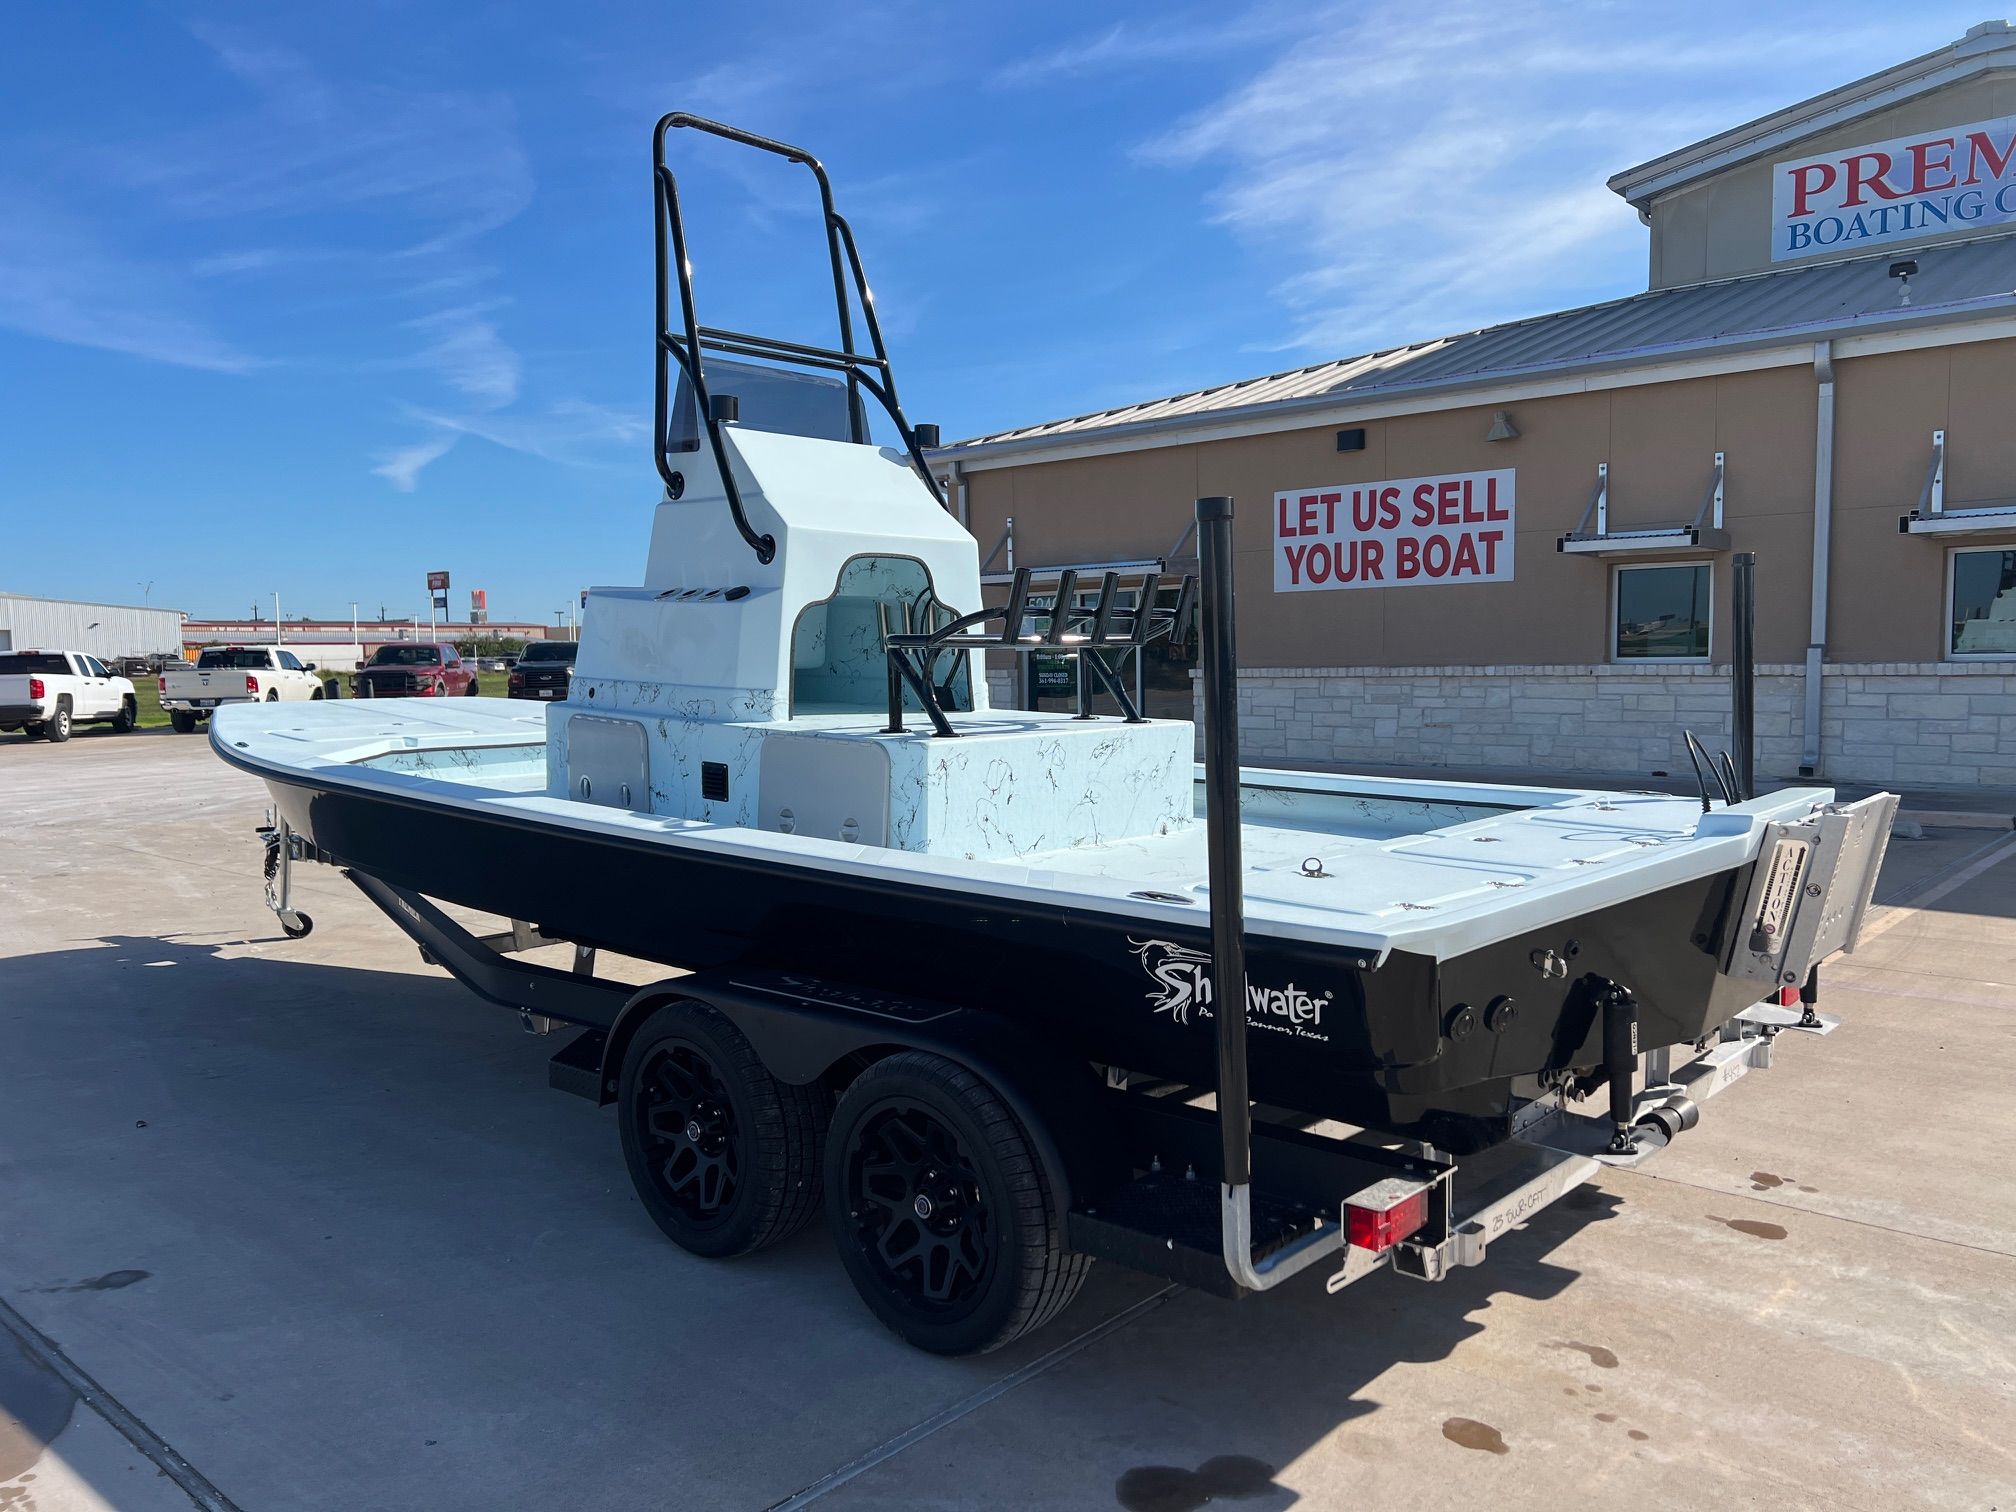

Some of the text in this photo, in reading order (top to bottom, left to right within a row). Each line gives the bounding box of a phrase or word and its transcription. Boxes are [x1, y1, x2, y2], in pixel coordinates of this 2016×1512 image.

[1787, 131, 2016, 218] PREM
[1787, 190, 1987, 251] BOATING
[1279, 478, 1509, 537] LET US SELL
[1284, 530, 1503, 585] YOUR BOAT
[1153, 962, 1330, 1025] Shlwater
[1294, 1025, 1329, 1042] Texas
